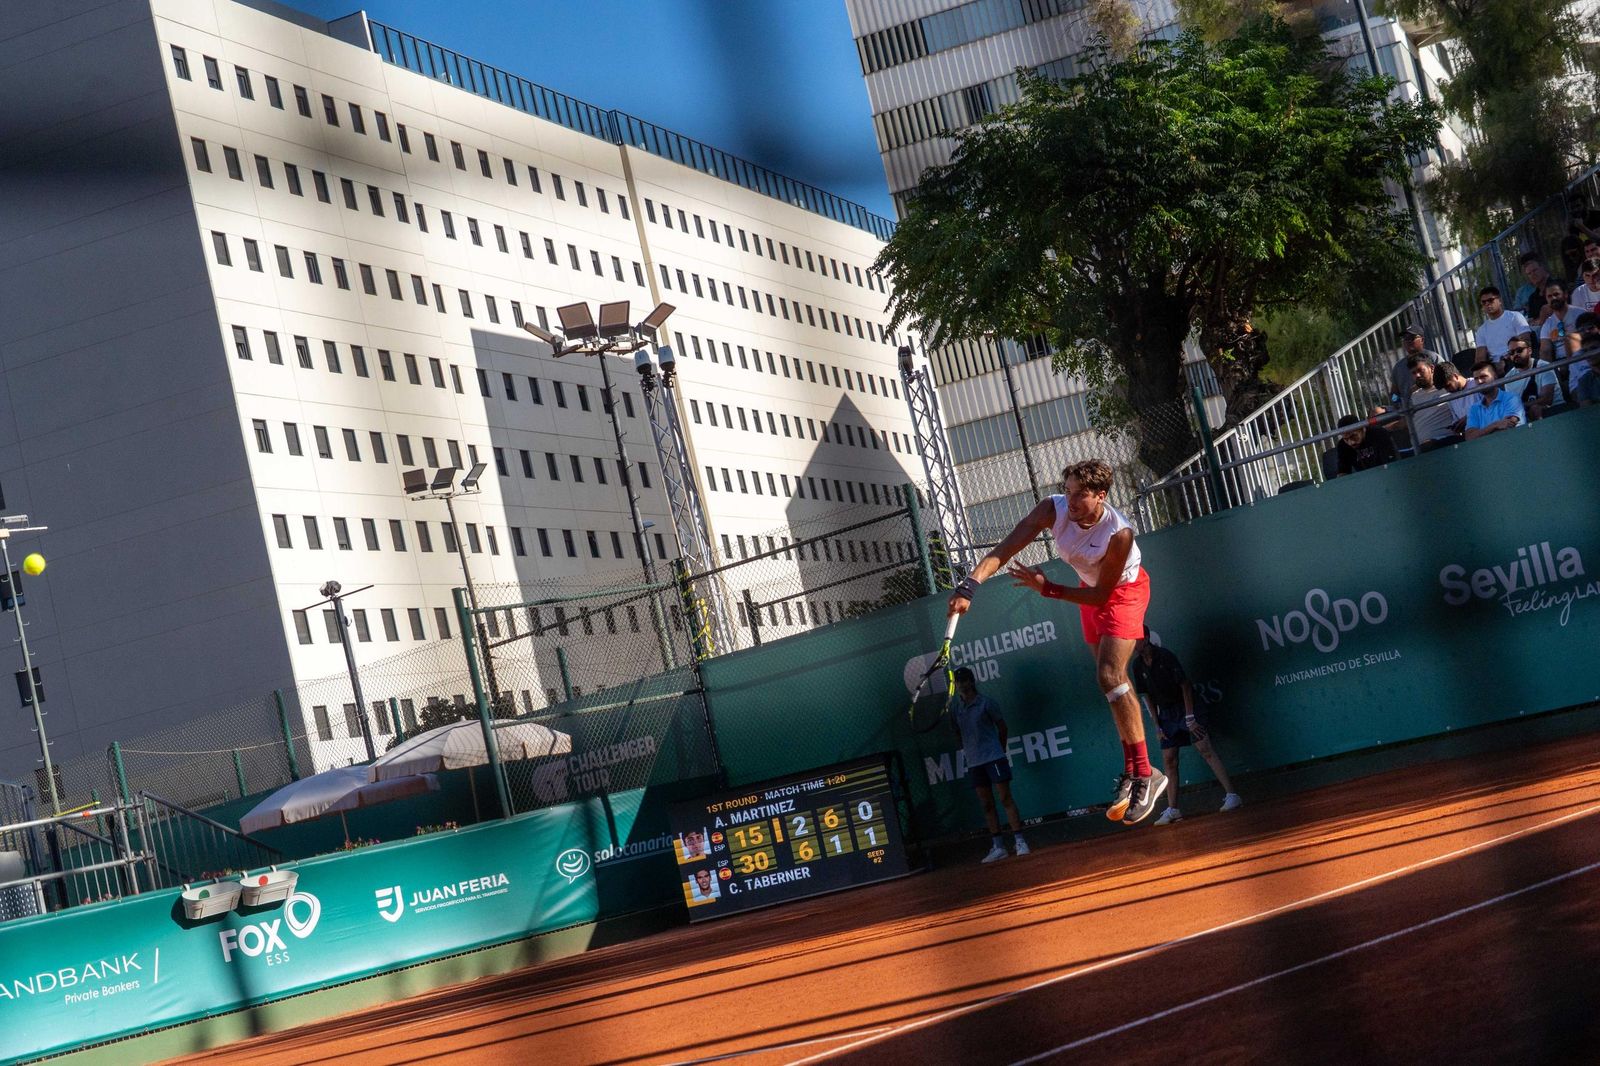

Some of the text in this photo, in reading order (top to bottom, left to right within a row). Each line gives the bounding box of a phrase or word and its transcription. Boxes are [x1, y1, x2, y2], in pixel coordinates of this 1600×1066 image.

[1439, 541, 1585, 606] Sevilla
[1502, 580, 1600, 627] Feeling LA
[950, 620, 1057, 667] CHALLENGER
[569, 735, 656, 773] CHALLENGER
[924, 724, 1073, 785] MAFRE
[573, 768, 610, 794] TOUR
[706, 774, 846, 814] 1ST ROUND MATCH TIME 1:20
[715, 799, 796, 829] A. MARTINEZ
[734, 801, 873, 848] 15 2 6 0
[714, 843, 726, 852] ESP
[717, 859, 729, 868] ESP
[739, 826, 877, 874] 30 6 1 1
[867, 849, 885, 859] SEED
[409, 872, 510, 906] JUAN FERIA
[729, 866, 811, 895] C. TABERNER
[218, 918, 288, 963] FOX
[266, 951, 290, 966] ESS
[64, 979, 141, 1006] Private Bankers
